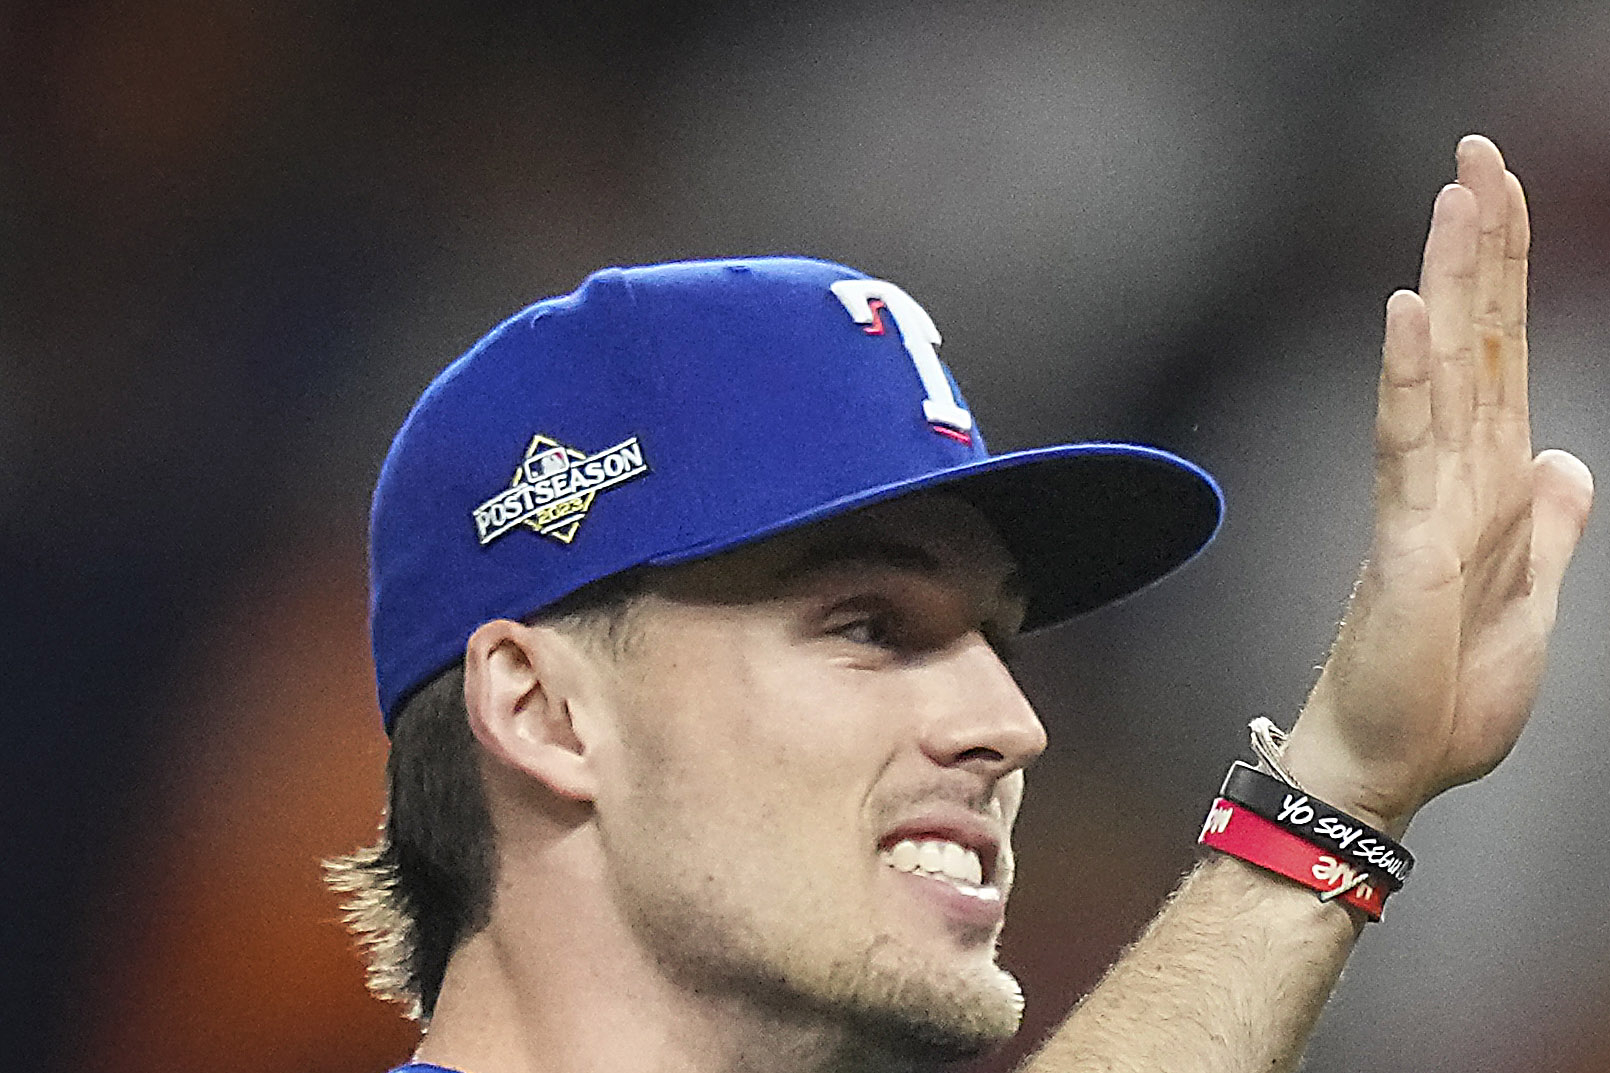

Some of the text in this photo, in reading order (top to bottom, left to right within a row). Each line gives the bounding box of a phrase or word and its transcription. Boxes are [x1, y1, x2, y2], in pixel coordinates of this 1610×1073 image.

[830, 279, 972, 440] T
[474, 443, 644, 538] POSTSEASON
[537, 497, 585, 525] 2023
[1277, 794, 1315, 825] YO
[1314, 817, 1364, 849] SOY
